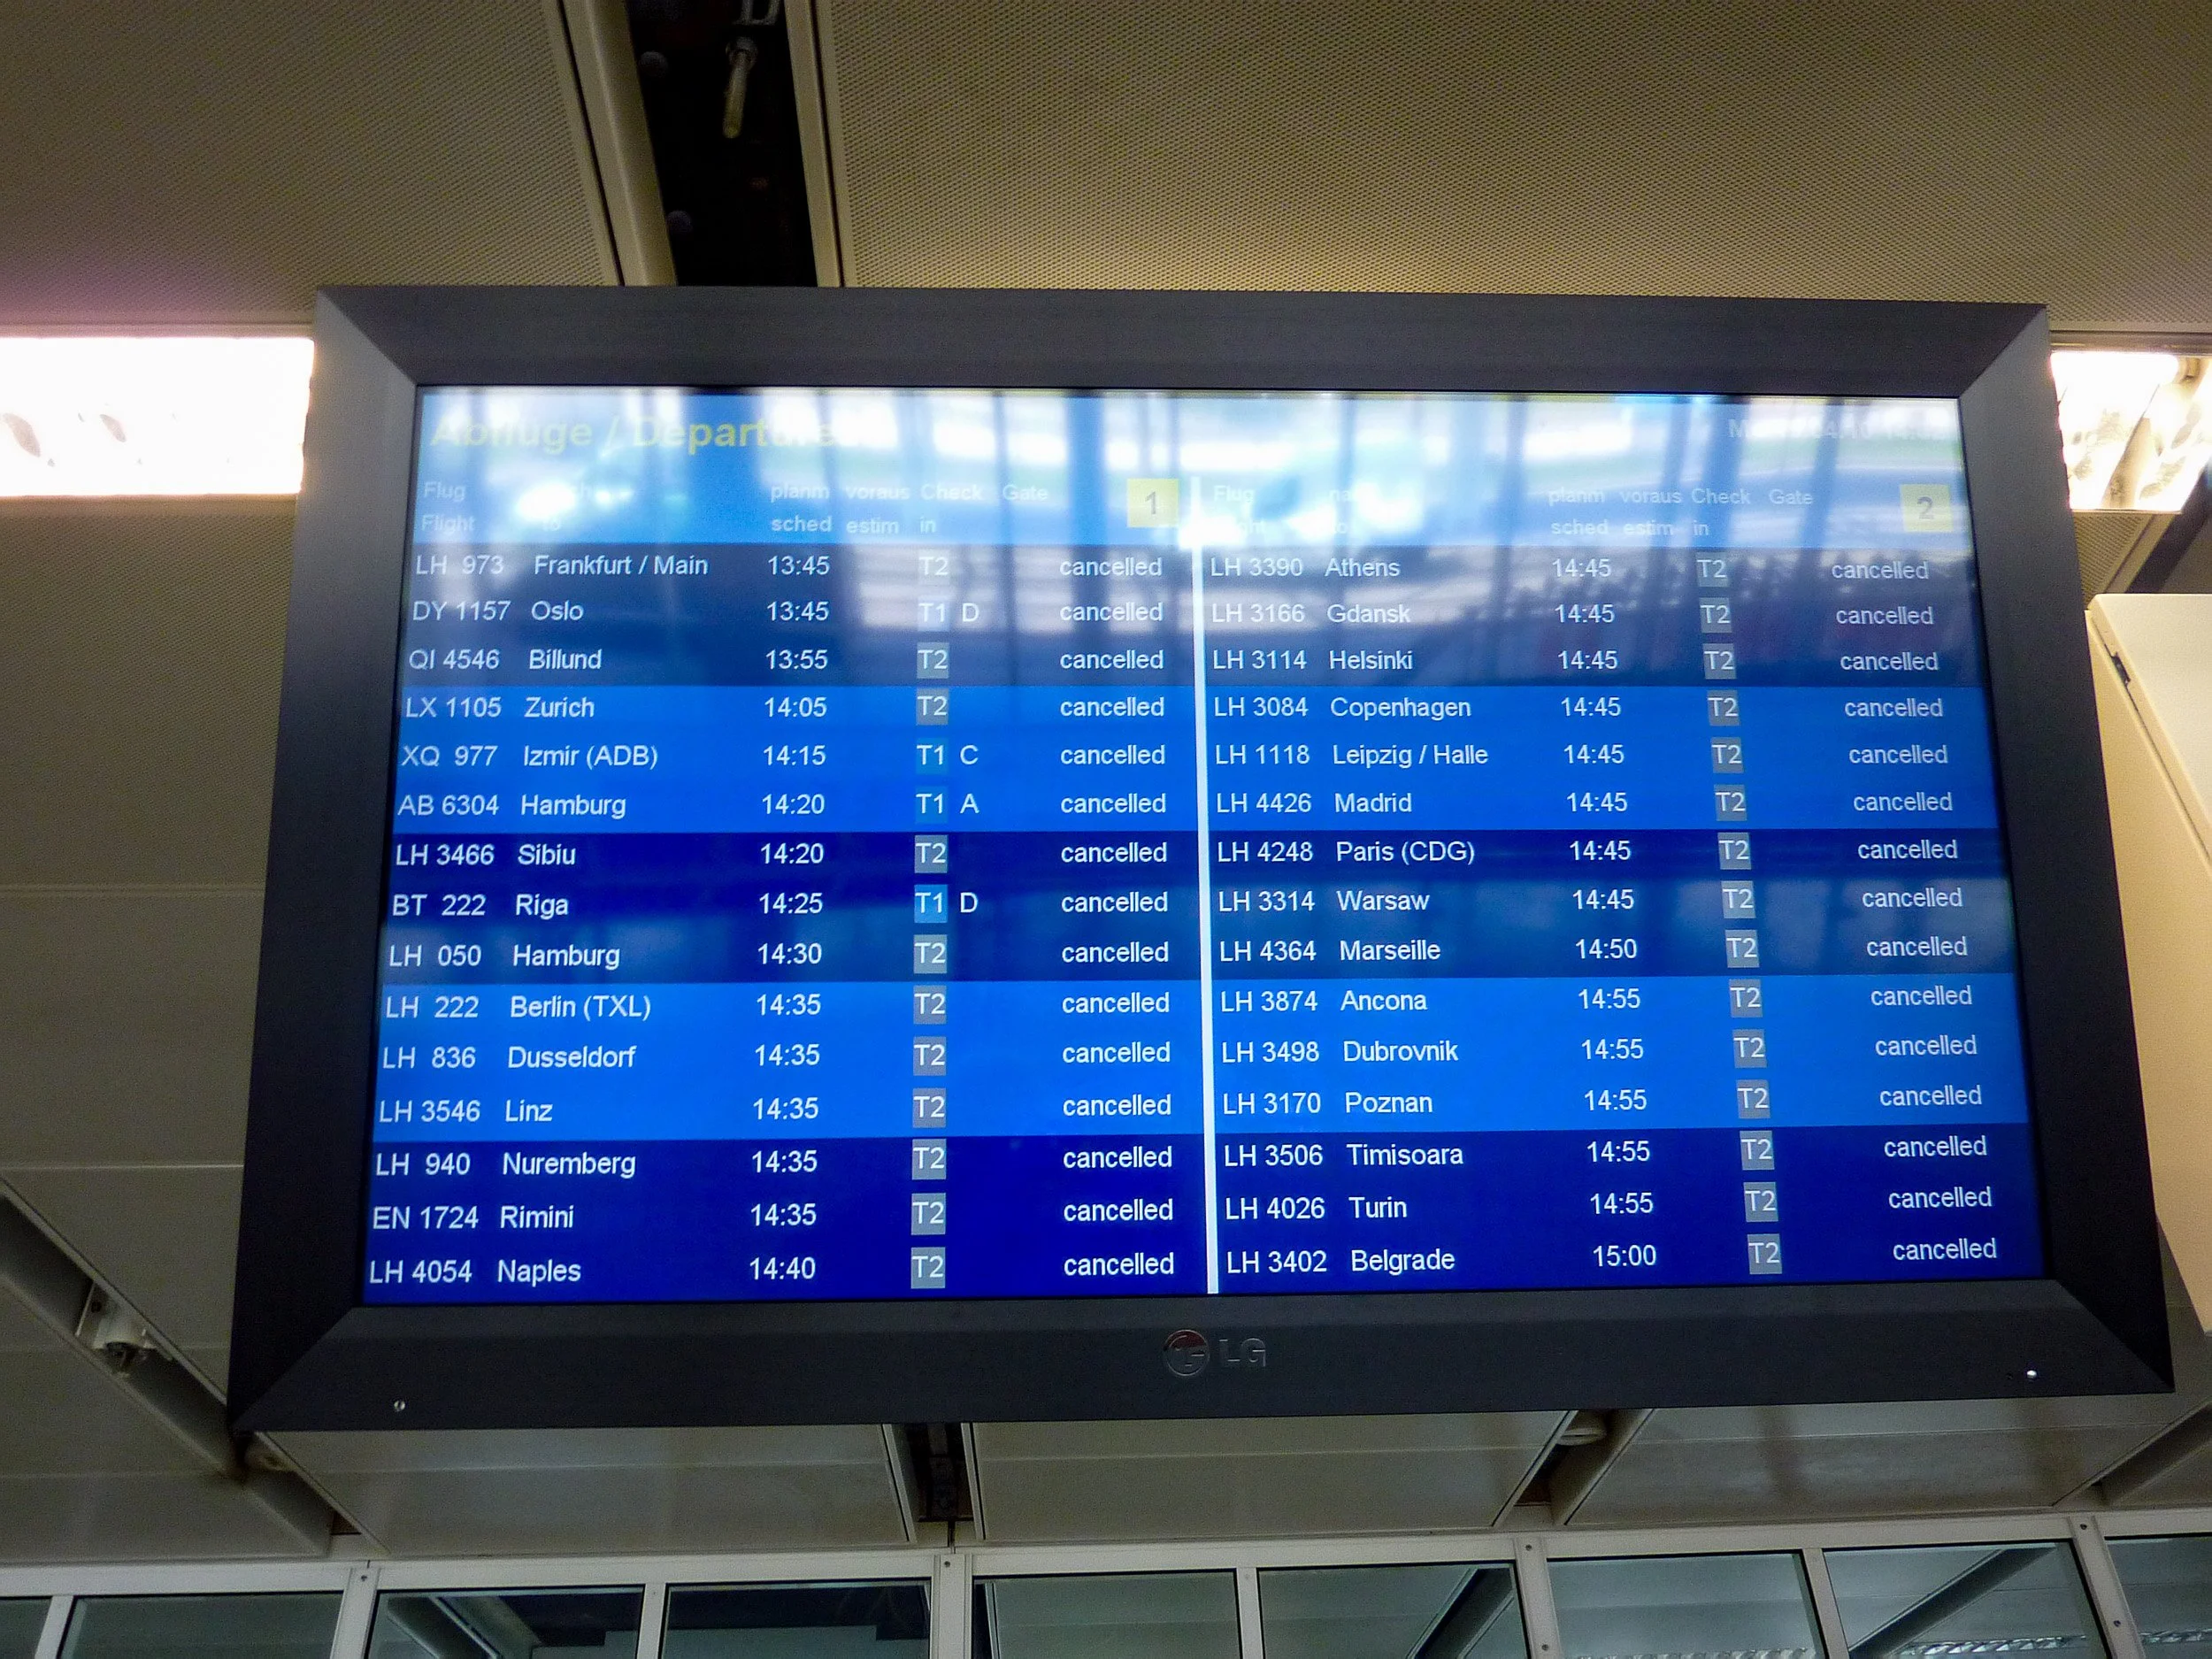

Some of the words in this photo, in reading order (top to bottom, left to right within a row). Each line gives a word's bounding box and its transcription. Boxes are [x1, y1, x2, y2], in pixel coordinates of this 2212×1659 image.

[425, 482, 465, 501] Flug
[771, 484, 829, 503] planm
[845, 486, 909, 501] voraus
[920, 484, 982, 501] Check
[1003, 485, 1048, 502] Gate
[1214, 486, 1254, 503] Flug
[1548, 488, 1604, 506] planm
[1620, 490, 1682, 504] voraus
[1692, 488, 1750, 505] Check
[1770, 489, 1813, 505] Gate
[1917, 496, 1933, 520] 2
[422, 515, 473, 534] Flight
[771, 516, 832, 533] sched
[846, 518, 899, 534] estim
[920, 518, 936, 534] in
[1551, 519, 1609, 536] sched
[1624, 520, 1673, 536] estim
[1694, 520, 1709, 536] in
[415, 556, 448, 575] LH
[461, 555, 505, 575] 973
[534, 555, 632, 575] Frankfurt
[637, 555, 649, 575] /
[653, 555, 708, 575] Main
[768, 555, 830, 576] 13:45
[1058, 557, 1164, 578] cancelled
[1210, 558, 1240, 578] LH
[1248, 557, 1303, 578] 3390
[1325, 557, 1401, 577] Athens
[1552, 557, 1612, 579] 14:45
[412, 601, 445, 622] DY
[455, 600, 512, 622] 1157
[530, 600, 584, 621] Oslo
[766, 601, 830, 622] 13:45
[918, 603, 948, 623] T1
[963, 603, 979, 622] D
[1211, 604, 1242, 623] LH
[1249, 603, 1306, 623] 3166
[1326, 603, 1412, 624] Gdansk
[1555, 603, 1616, 624] 14:45
[408, 649, 435, 670] QI
[442, 649, 500, 670] 4546
[528, 648, 603, 670] Billund
[765, 649, 828, 671] 13:55
[918, 649, 948, 670] T2
[1212, 649, 1244, 670] LH
[1249, 648, 1309, 672] 3114
[1329, 649, 1413, 670] Helsinki
[1557, 649, 1618, 670] 14:45
[1839, 651, 1939, 671] cancelled
[405, 696, 437, 718] LX
[444, 695, 503, 719] 1105
[523, 695, 595, 718] Zurich
[764, 696, 827, 718] 14:05
[1214, 696, 1246, 718] LH
[1252, 696, 1309, 718] 3084
[1330, 696, 1472, 722] Copenhagen
[1561, 696, 1622, 717] 14:45
[1707, 696, 1739, 717] T2
[401, 745, 441, 767] XQ
[454, 744, 498, 767] 977
[523, 744, 580, 767] Izmir
[586, 744, 658, 770] (ADB)
[763, 744, 826, 766] 14:15
[916, 743, 944, 765] T1
[959, 744, 979, 765] C
[1060, 744, 1165, 765] cancelled
[1215, 744, 1247, 765] LH
[1255, 744, 1310, 765] 1118
[1333, 744, 1413, 769] Leipzig
[1418, 744, 1428, 764] /
[1432, 744, 1489, 765] Halle
[1563, 743, 1625, 764] 14:45
[396, 794, 434, 817] AB
[441, 794, 500, 816] 6304
[520, 794, 626, 820] Hamburg
[762, 793, 826, 815] 14:20
[915, 793, 943, 815] T1
[959, 793, 980, 814] A
[396, 843, 429, 866] LH
[435, 843, 495, 866] 3466
[517, 843, 577, 866] Sibiu
[760, 842, 825, 864] 14:20
[1217, 841, 1249, 863] LH
[1256, 841, 1314, 863] 4248
[1336, 841, 1394, 863] Paris
[1401, 840, 1476, 866] (CDG)
[1569, 840, 1632, 861] 14:45
[1857, 839, 1958, 860] cancelled
[392, 894, 428, 917] BT
[441, 893, 487, 917] 222
[515, 893, 569, 921] Riga
[758, 892, 824, 915] 14:25
[914, 891, 943, 914] T1
[959, 891, 979, 914] D
[1217, 890, 1251, 912] LH
[1257, 890, 1316, 912] 3314
[1335, 889, 1431, 911] Warsaw
[1571, 888, 1635, 910] 14:45
[388, 944, 422, 967] LH
[437, 944, 482, 967] 050
[512, 943, 620, 972] Hamburg
[757, 941, 823, 965] 14:30
[914, 941, 946, 964] T2
[1061, 941, 1170, 964] cancelled
[1219, 940, 1252, 963] LH
[1259, 940, 1317, 962] 4364
[1340, 939, 1441, 962] Marseille
[1575, 938, 1638, 960] 14:50
[385, 995, 419, 1018] LH
[434, 995, 480, 1018] 222
[510, 995, 577, 1018] Berlin
[582, 994, 651, 1022] (TXL)
[756, 993, 822, 1017] 14:35
[1220, 990, 1253, 1013] LH
[1260, 990, 1318, 1012] 3874
[1340, 989, 1429, 1011] Ancona
[1578, 987, 1641, 1010] 14:55
[1870, 984, 1973, 1006] cancelled
[379, 1100, 413, 1123] LH
[420, 1099, 481, 1123] 3546
[504, 1099, 554, 1123] Linz
[752, 1096, 819, 1120] 14:35
[1223, 1092, 1256, 1115] LH
[1263, 1092, 1322, 1115] 3170
[1345, 1091, 1433, 1114] Poznan
[1584, 1088, 1647, 1111] 14:55
[373, 1205, 411, 1230] EN
[419, 1205, 480, 1230] 1724
[500, 1204, 574, 1229] Rimini
[750, 1202, 818, 1227] 14:35
[1225, 1196, 1258, 1220] LH
[1266, 1196, 1325, 1220] 4026
[1347, 1194, 1409, 1220] Turin
[1589, 1191, 1654, 1215] 14:55
[1226, 1250, 1260, 1274] LH
[1267, 1249, 1328, 1273] 3402
[1350, 1248, 1455, 1277] Belgrade
[1593, 1243, 1657, 1268] 15:00
[1747, 1241, 1780, 1264] T2
[1892, 1236, 1998, 1261] cancelled
[369, 1259, 403, 1284] LH
[411, 1259, 473, 1284] 4054
[496, 1258, 581, 1288] Naples
[749, 1256, 817, 1281] 14:40
[1064, 1251, 1175, 1277] cancelled
[1218, 1337, 1267, 1367] LG
